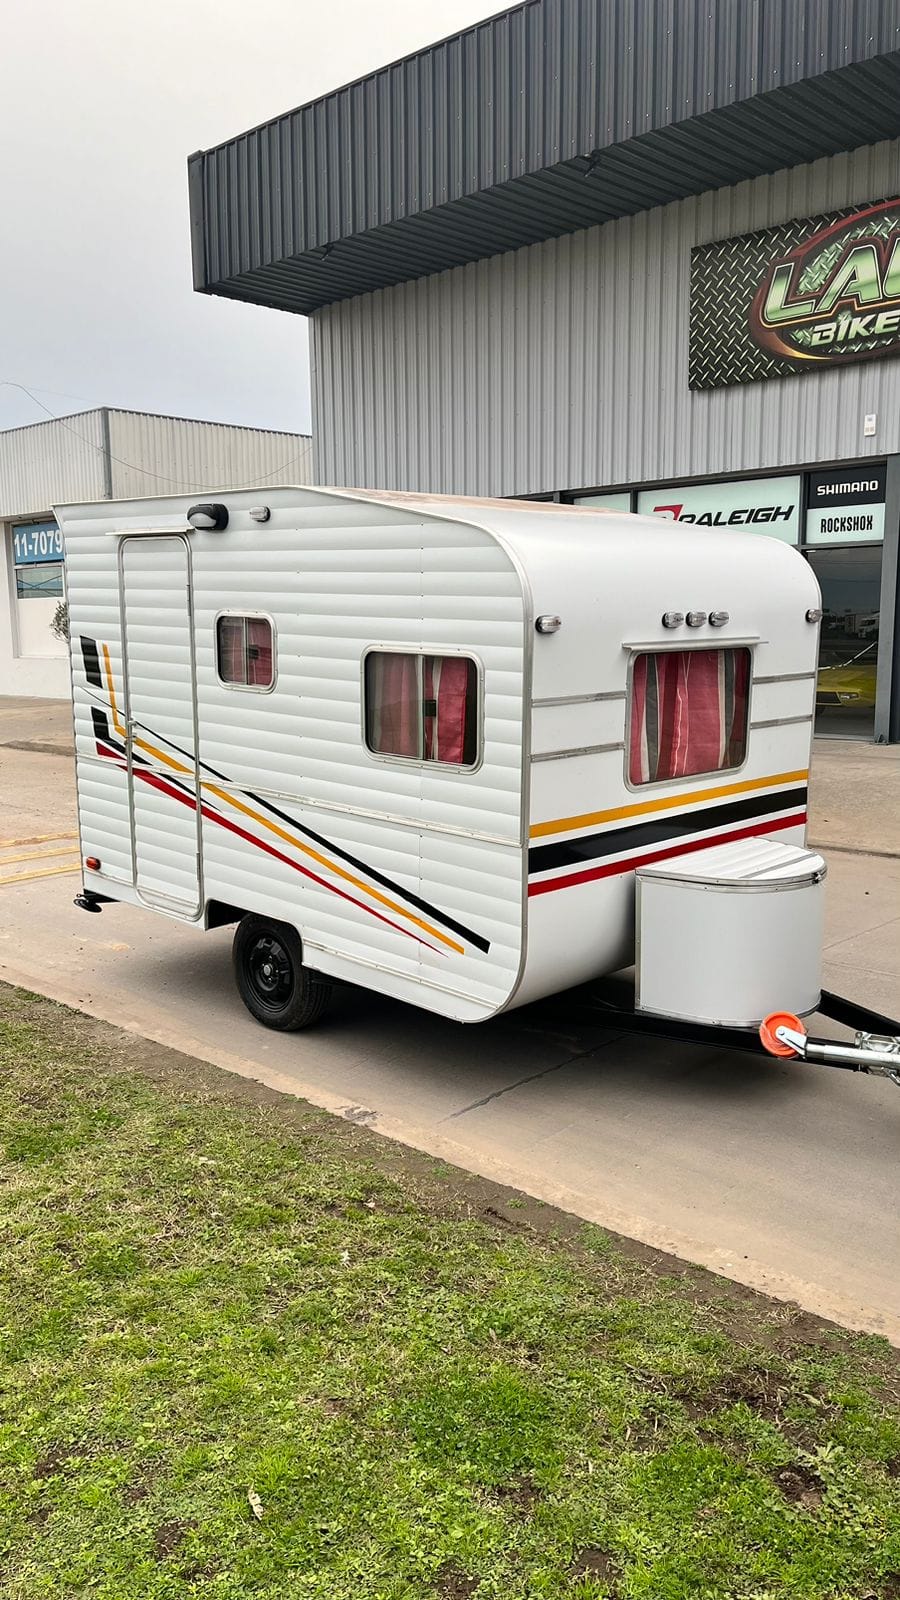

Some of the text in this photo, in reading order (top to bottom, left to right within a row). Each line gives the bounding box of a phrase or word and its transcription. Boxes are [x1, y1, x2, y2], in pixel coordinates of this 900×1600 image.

[817, 480, 879, 496] SHIMANO
[820, 515, 873, 533] ROCKSHOX
[15, 531, 63, 556] 11-7079
